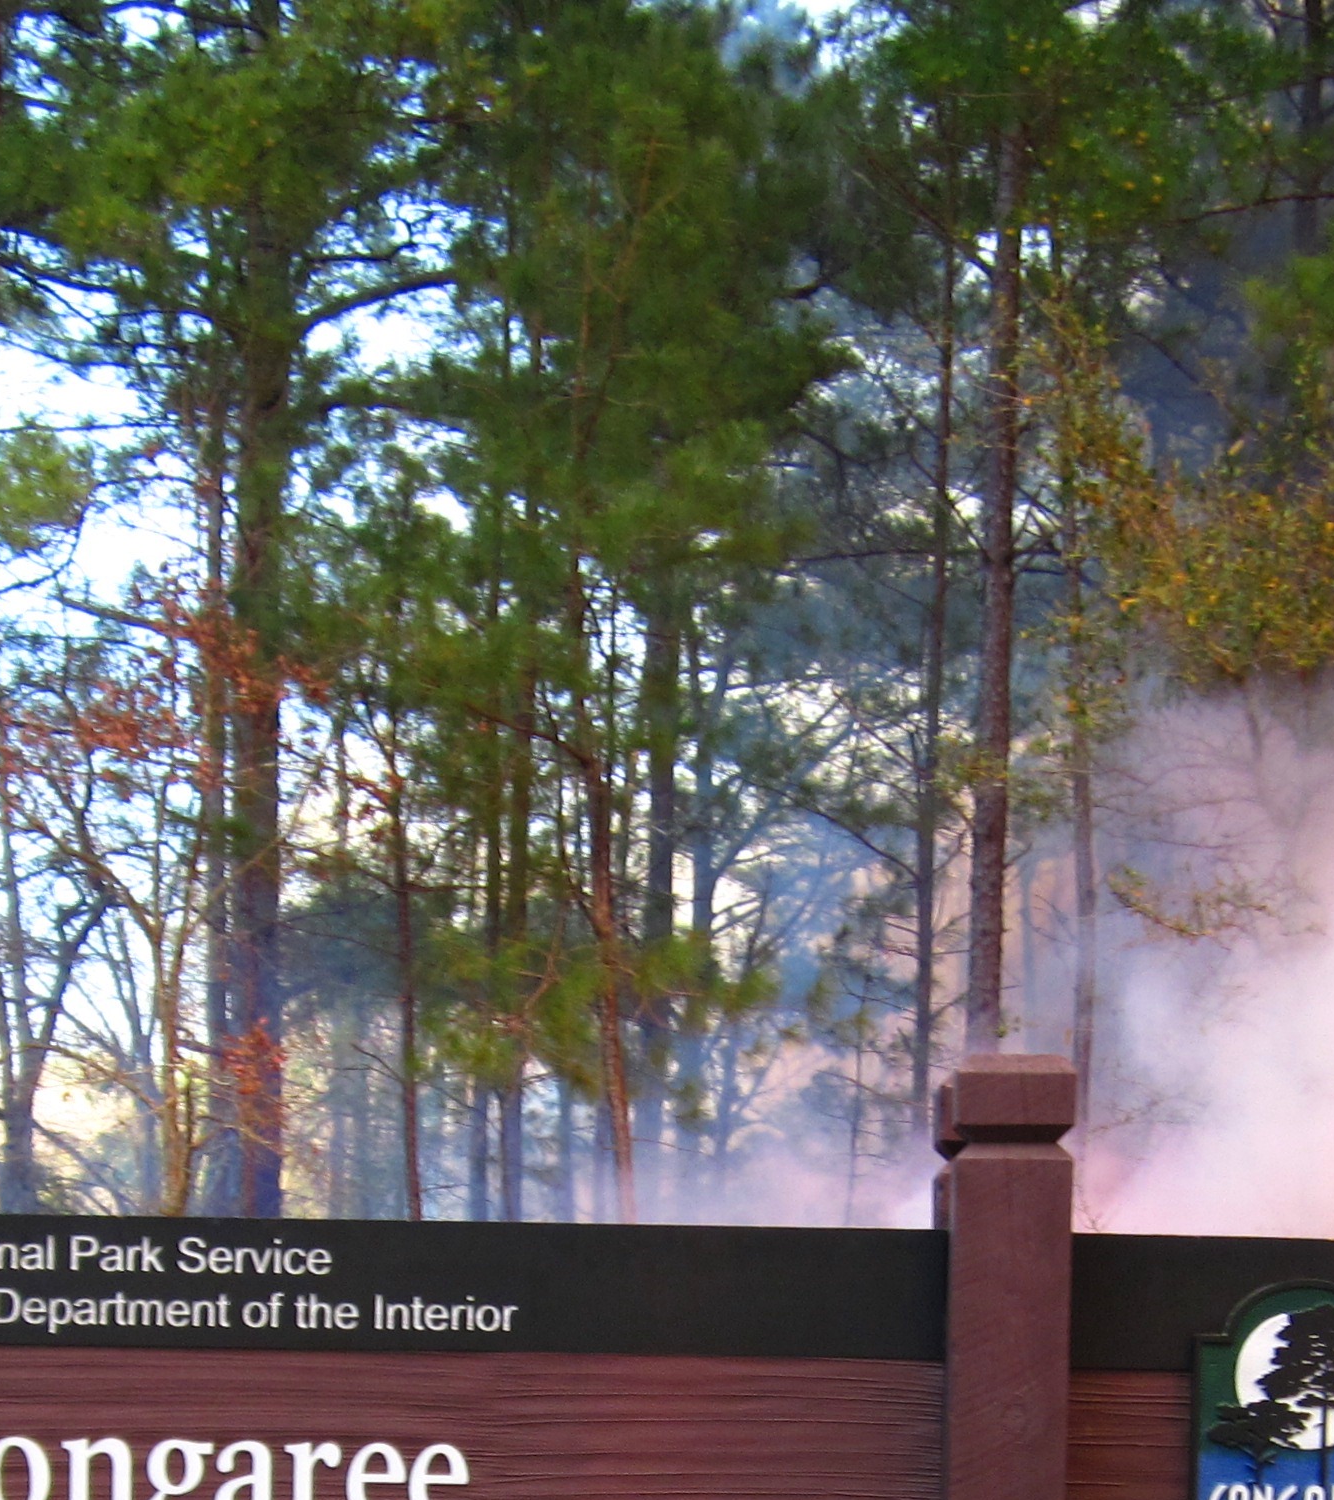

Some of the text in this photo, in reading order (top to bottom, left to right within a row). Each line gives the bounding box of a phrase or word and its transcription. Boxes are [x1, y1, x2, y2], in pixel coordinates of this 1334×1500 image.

[69, 1235, 165, 1273] Park
[175, 1236, 333, 1276] Service
[241, 1292, 285, 1330] of
[292, 1293, 360, 1330] the
[372, 1294, 520, 1333] Interior
